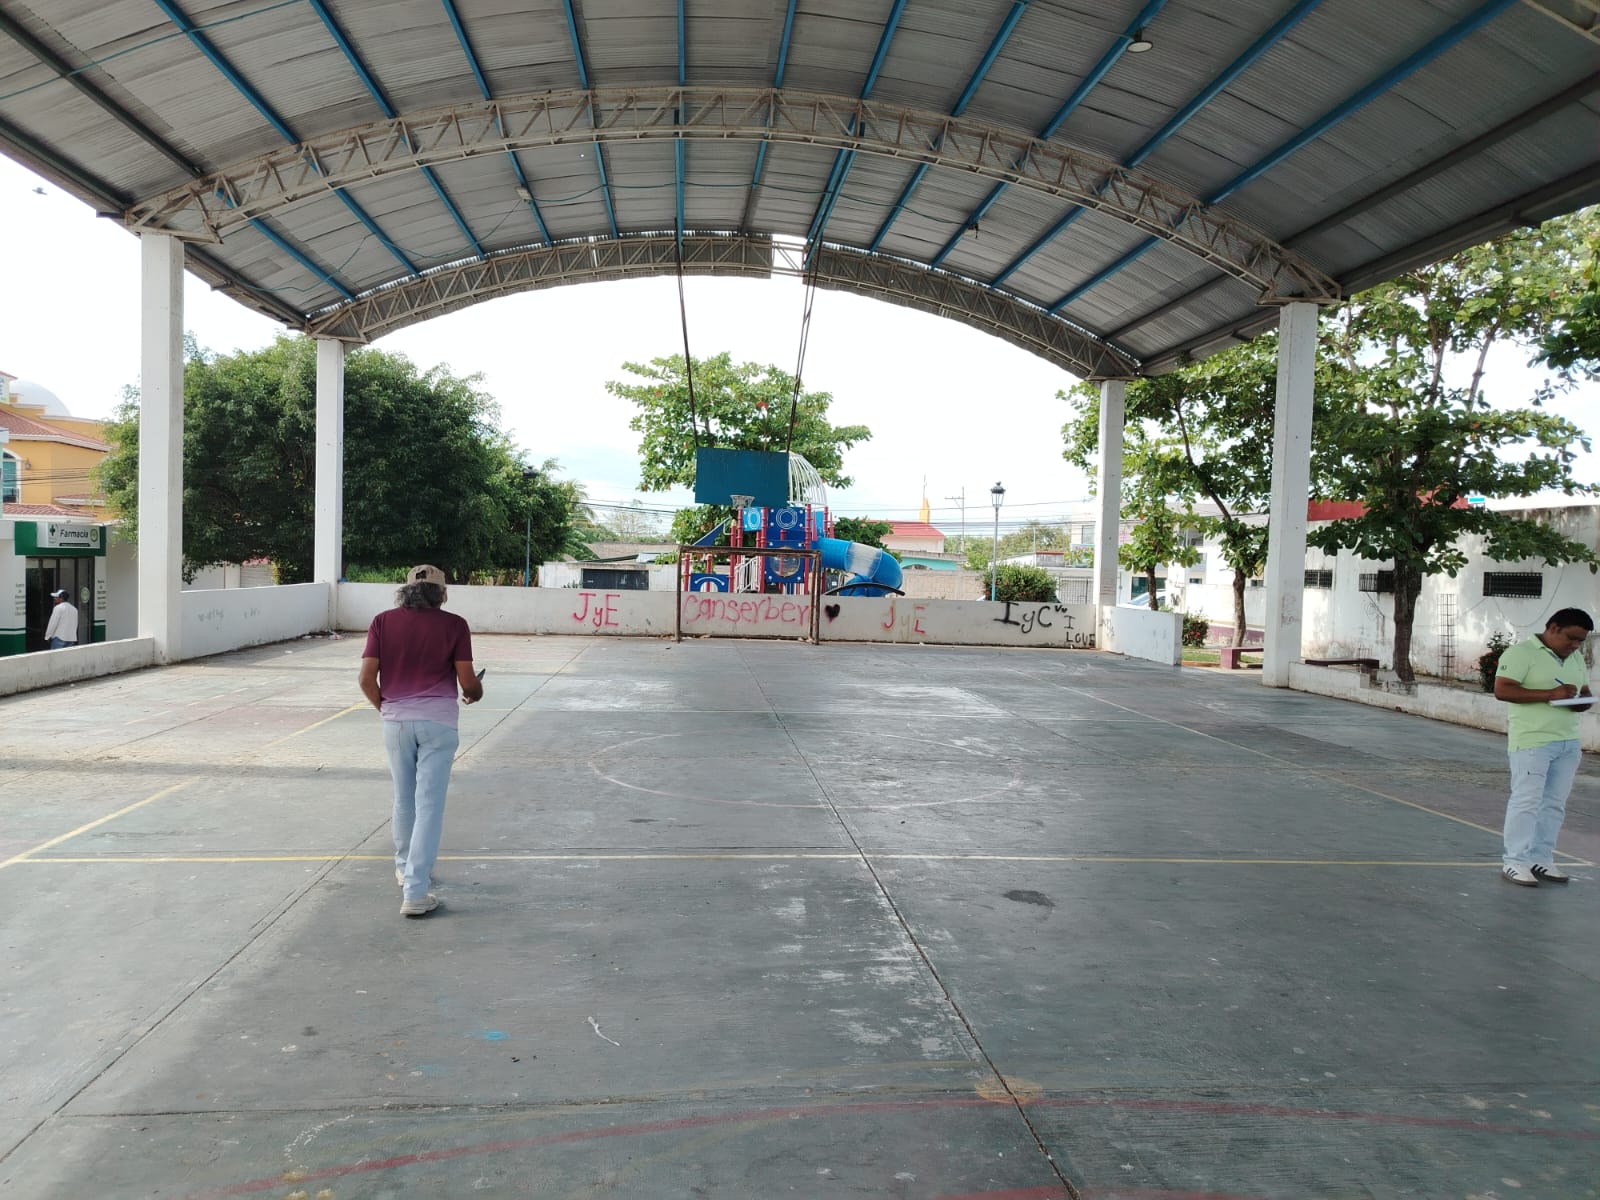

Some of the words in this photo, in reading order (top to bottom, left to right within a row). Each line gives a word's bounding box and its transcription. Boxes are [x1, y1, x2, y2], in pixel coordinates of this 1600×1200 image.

[60, 529, 89, 538] Farmacia
[573, 592, 621, 628] JyE
[993, 601, 1053, 634] IyC
